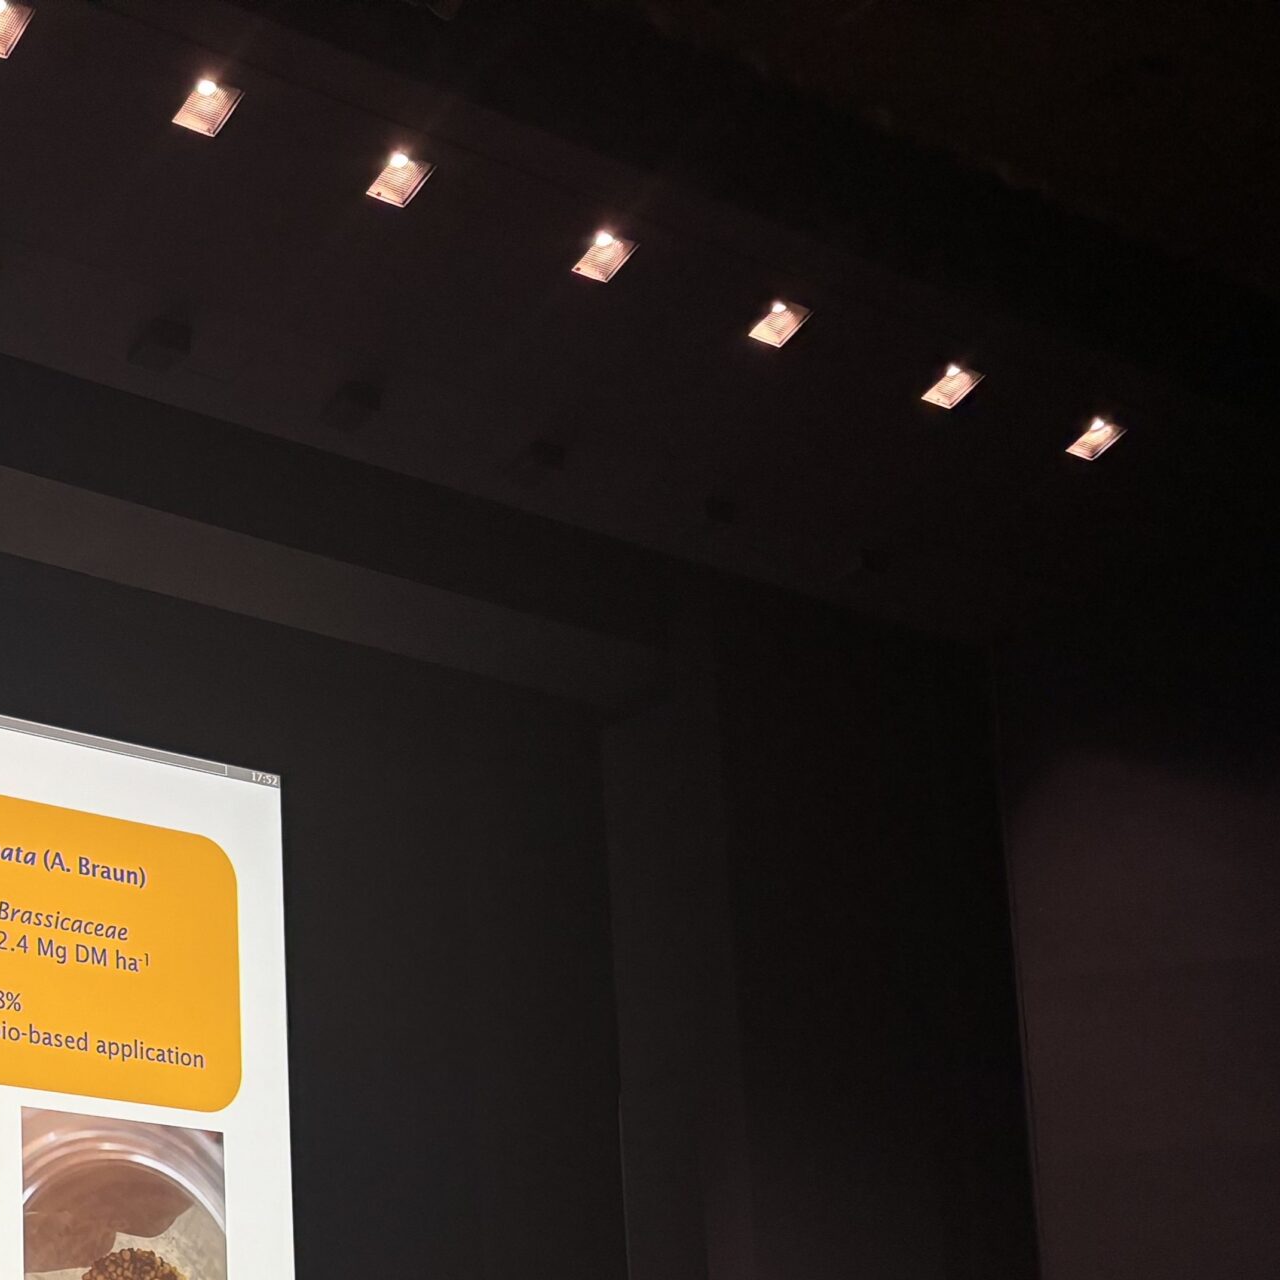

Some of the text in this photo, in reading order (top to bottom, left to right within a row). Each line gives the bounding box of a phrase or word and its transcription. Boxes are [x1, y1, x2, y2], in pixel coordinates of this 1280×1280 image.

[251, 771, 278, 786] 17:52
[43, 849, 71, 872] (A.
[79, 856, 145, 888] Braun)
[38, 937, 66, 964] Mg
[76, 944, 107, 967] DM
[96, 1039, 204, 1068] application
